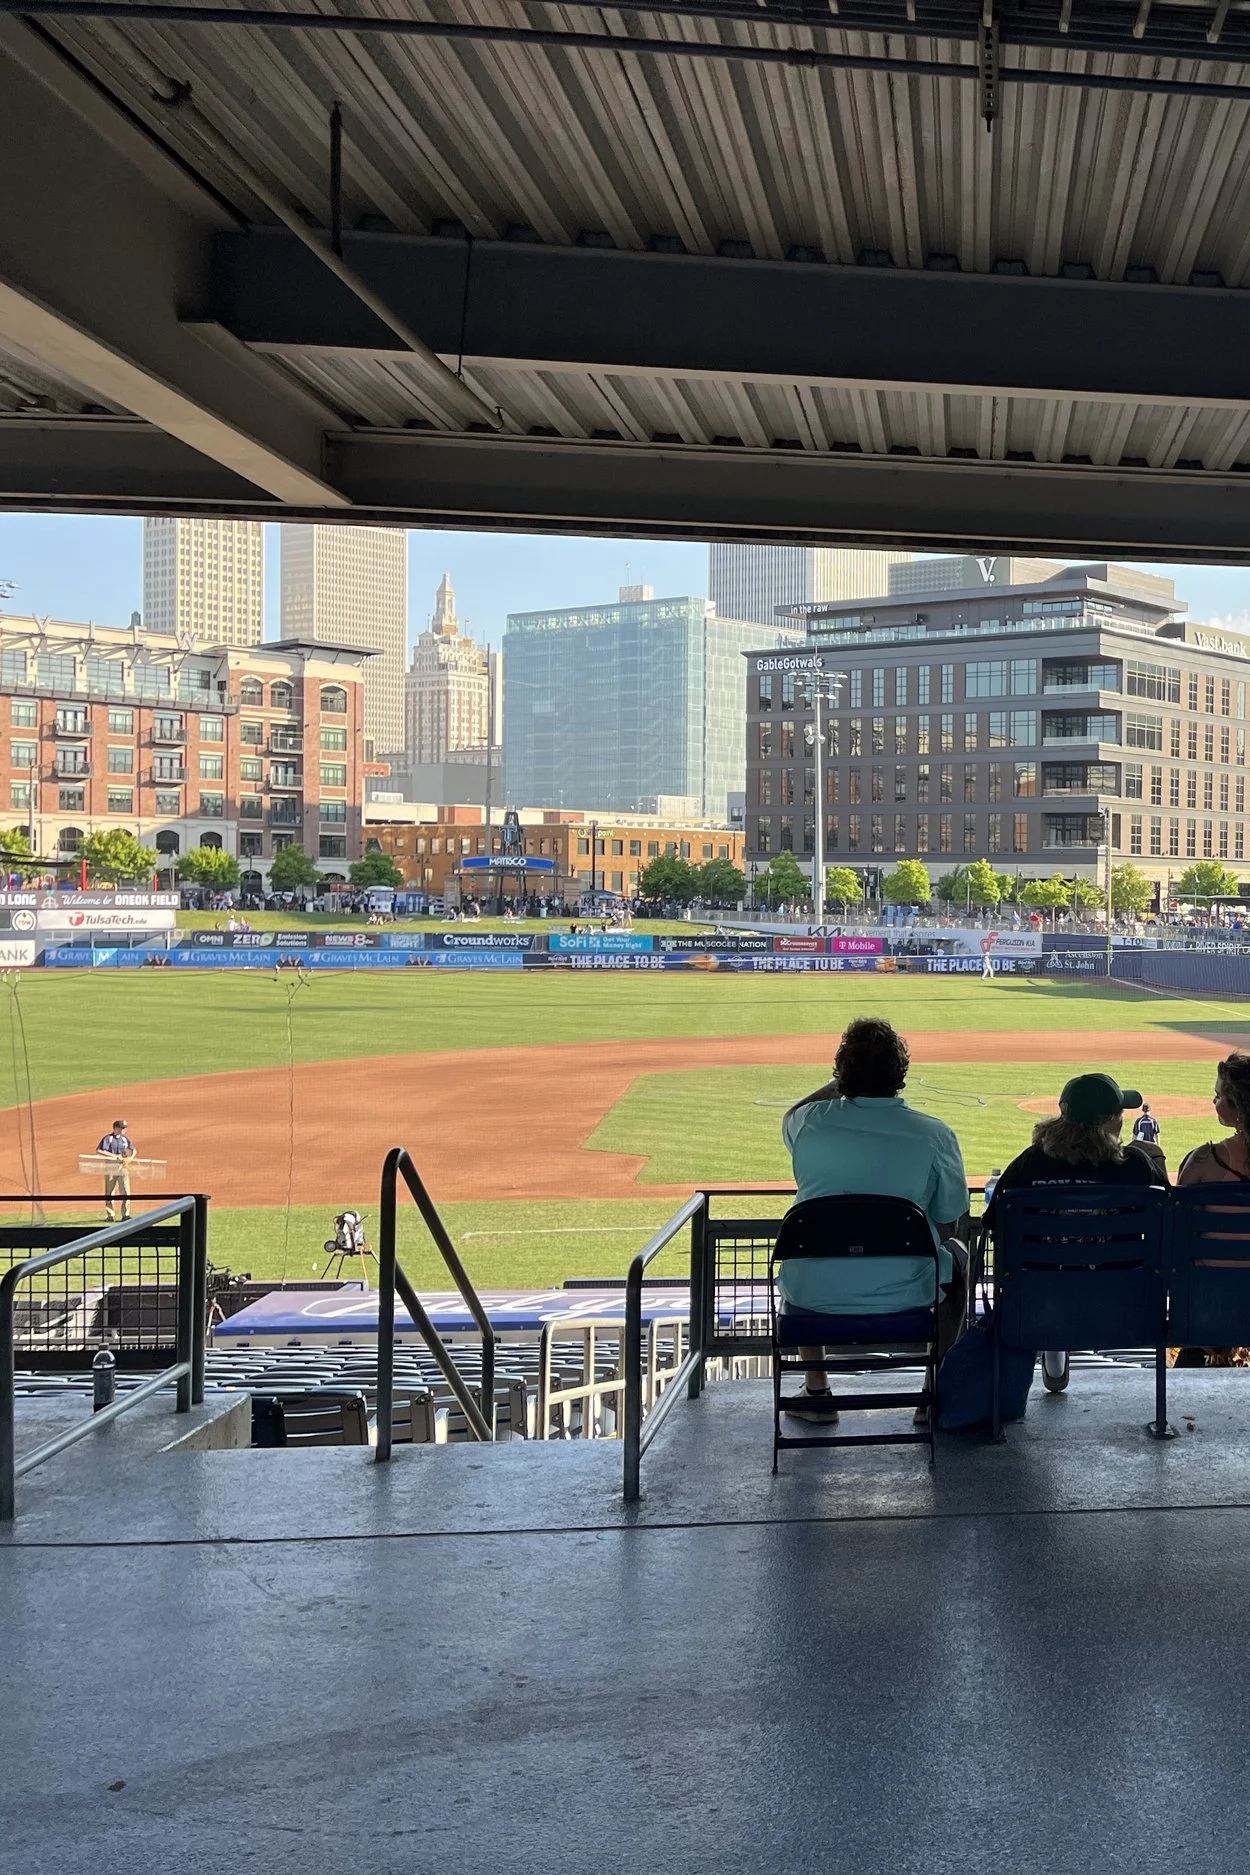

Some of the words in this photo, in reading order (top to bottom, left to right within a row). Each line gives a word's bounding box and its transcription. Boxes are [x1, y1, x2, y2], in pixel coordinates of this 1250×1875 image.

[790, 605, 799, 614] in
[799, 604, 812, 613] the
[813, 604, 829, 613] raw
[756, 655, 824, 672] GableGotwals
[7, 893, 37, 906] LONG
[61, 894, 101, 905] Welcome
[102, 895, 112, 905] to
[114, 894, 149, 906] ONEOK
[150, 894, 179, 906] FIELD
[86, 913, 148, 925] TulsaTech.edu
[354, 933, 367, 947] 8
[443, 934, 530, 946] Groundworks
[559, 936, 587, 948] SoFi
[678, 940, 693, 948] THE
[694, 940, 737, 948] MUSCOGEE
[739, 940, 767, 948] NATION
[1121, 937, 1144, 946] T-TO
[1195, 940, 1216, 954] RIVER
[1216, 940, 1242, 956] SPIRIT
[0, 948, 29, 961] ANK
[191, 951, 228, 962] GRAVES
[320, 952, 358, 963] GRAVES
[447, 953, 482, 964] GRAVES
[569, 955, 594, 969] THE
[594, 955, 631, 969] PLACE
[633, 955, 649, 969] TO
[650, 955, 666, 969] BE
[751, 956, 775, 970] THE
[774, 957, 811, 970] PLACE
[814, 957, 829, 970] TO
[829, 958, 845, 971] BE
[926, 958, 948, 972] THE
[948, 958, 982, 972] PLACE
[1001, 959, 1016, 972] BE
[1063, 960, 1075, 969] St.
[1075, 961, 1095, 970] John
